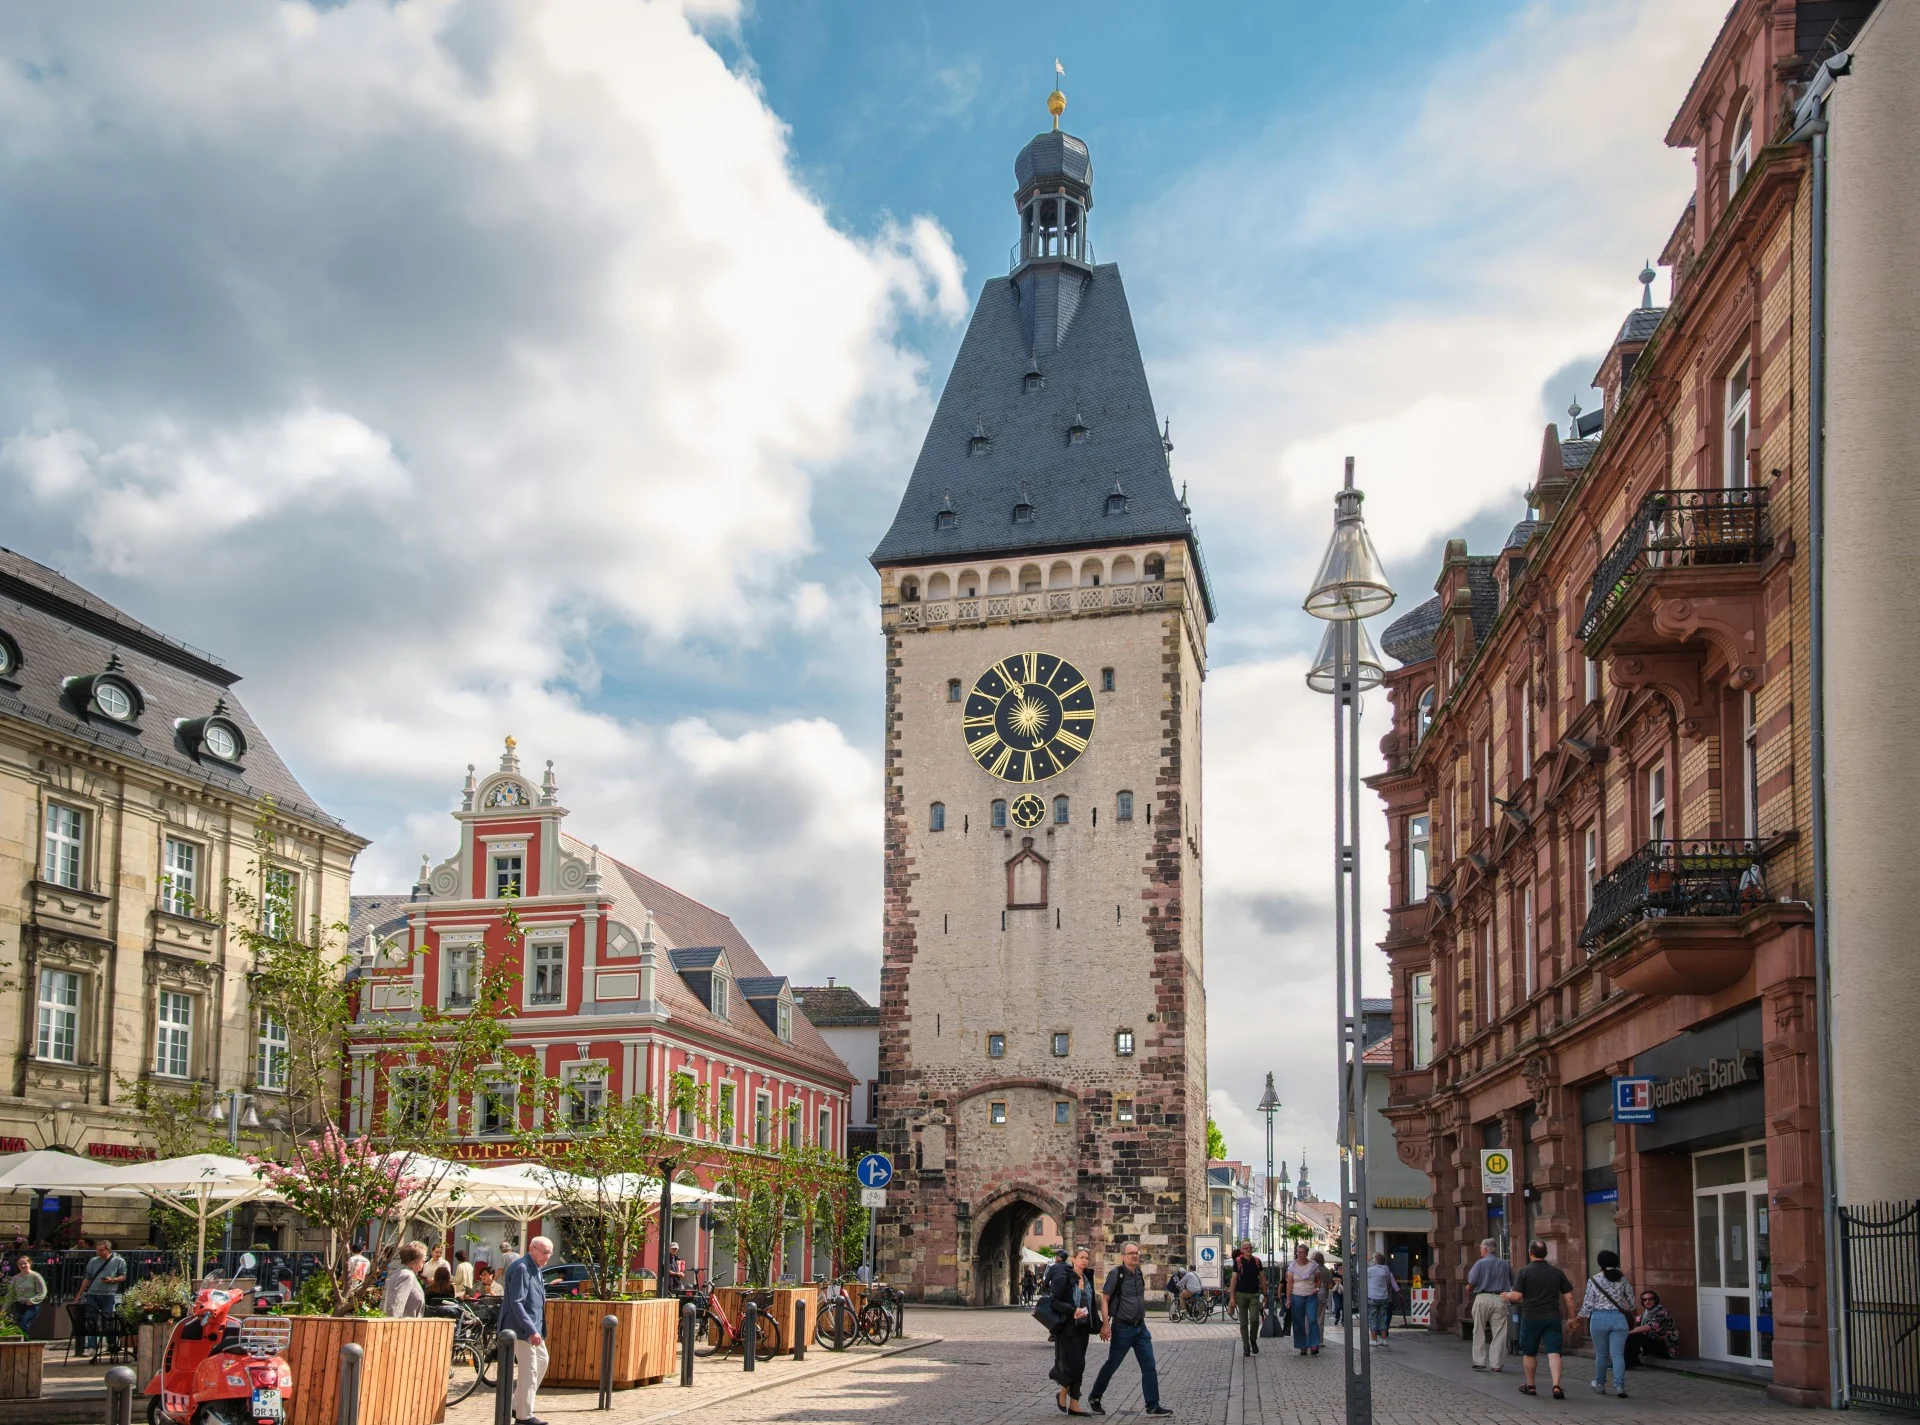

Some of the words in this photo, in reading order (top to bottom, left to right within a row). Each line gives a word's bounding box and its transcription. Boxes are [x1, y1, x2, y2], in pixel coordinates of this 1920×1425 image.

[1648, 1066, 1704, 1111] Deutsche
[1709, 1049, 1748, 1091] Bank
[1491, 1157, 1502, 1170] H
[1374, 1196, 1428, 1209] WILHELM
[263, 1390, 276, 1399] SP
[268, 1408, 280, 1417] 11
